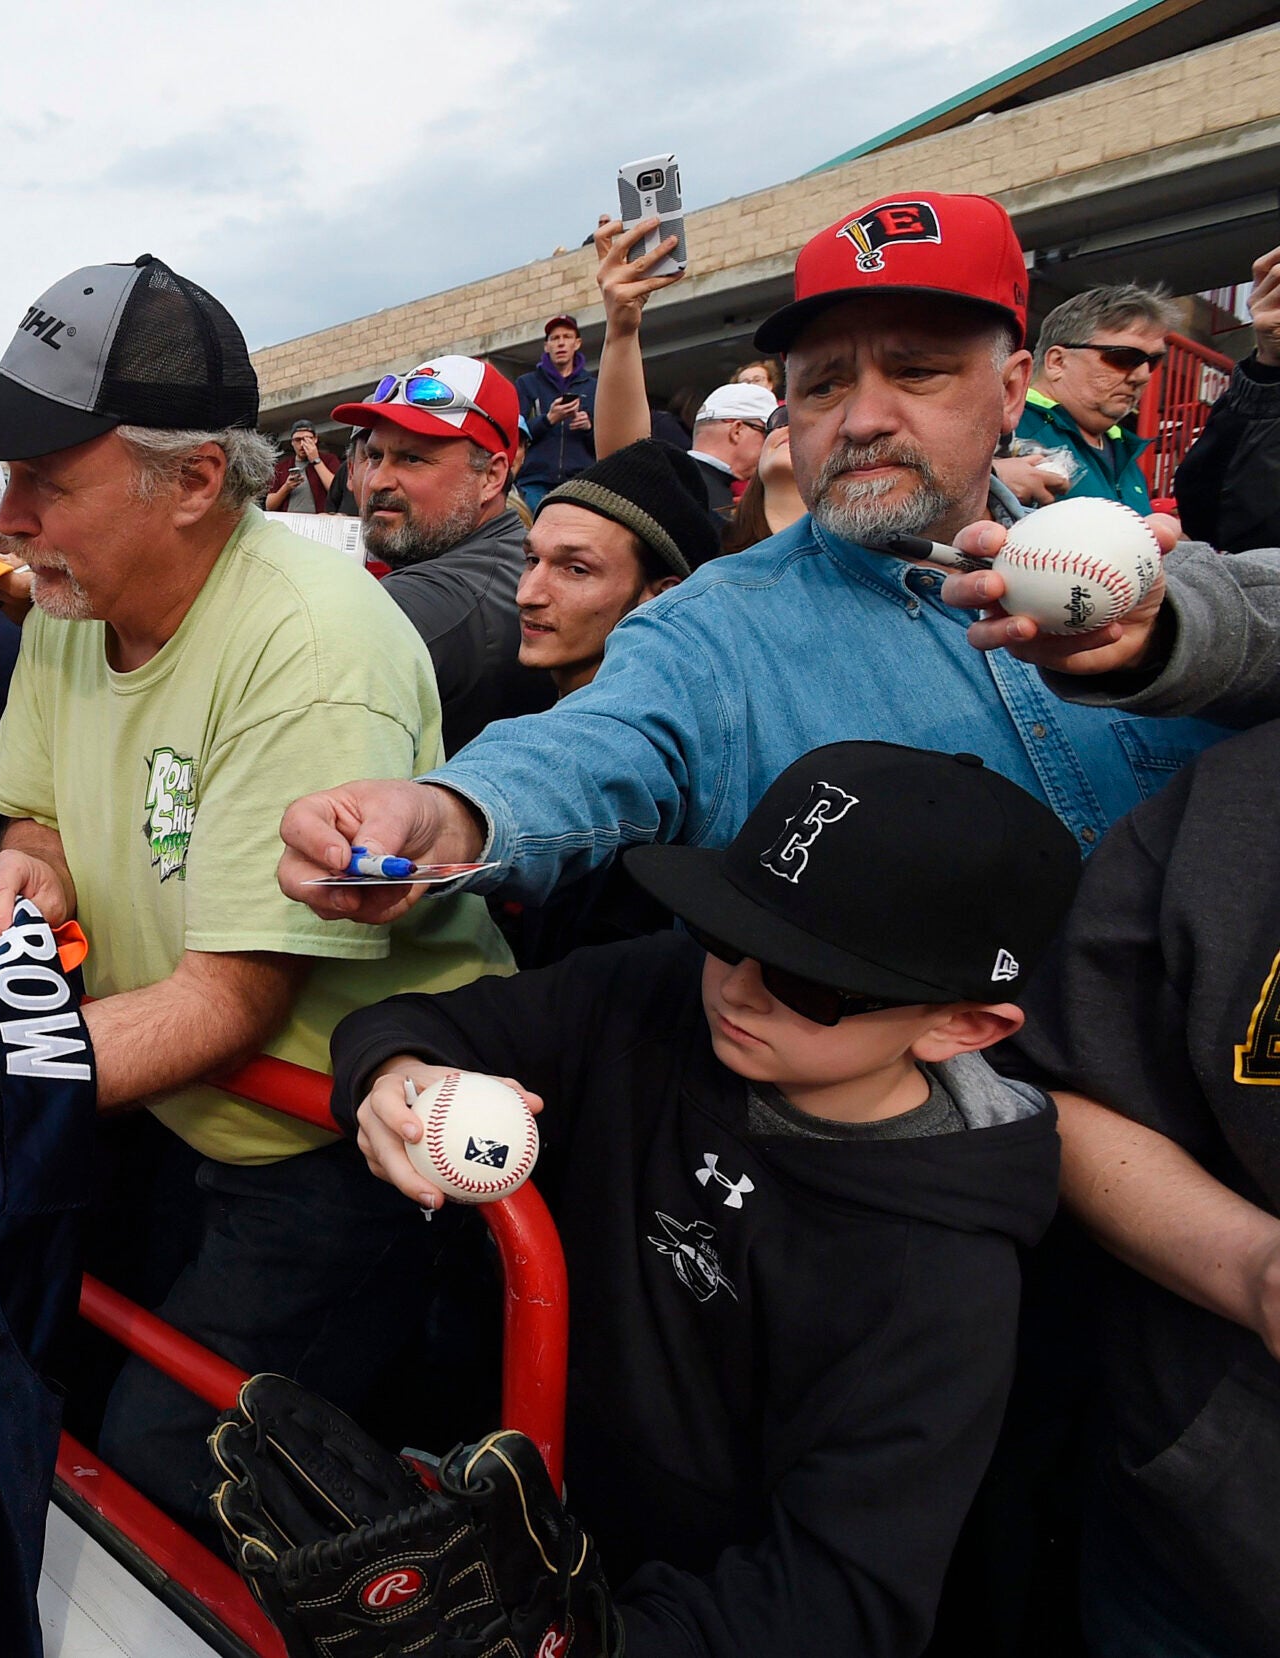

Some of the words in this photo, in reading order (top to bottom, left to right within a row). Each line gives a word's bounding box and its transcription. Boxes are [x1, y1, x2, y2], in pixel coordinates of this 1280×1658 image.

[875, 206, 925, 236] E
[1064, 584, 1091, 628] Rawlings
[760, 781, 860, 884] E
